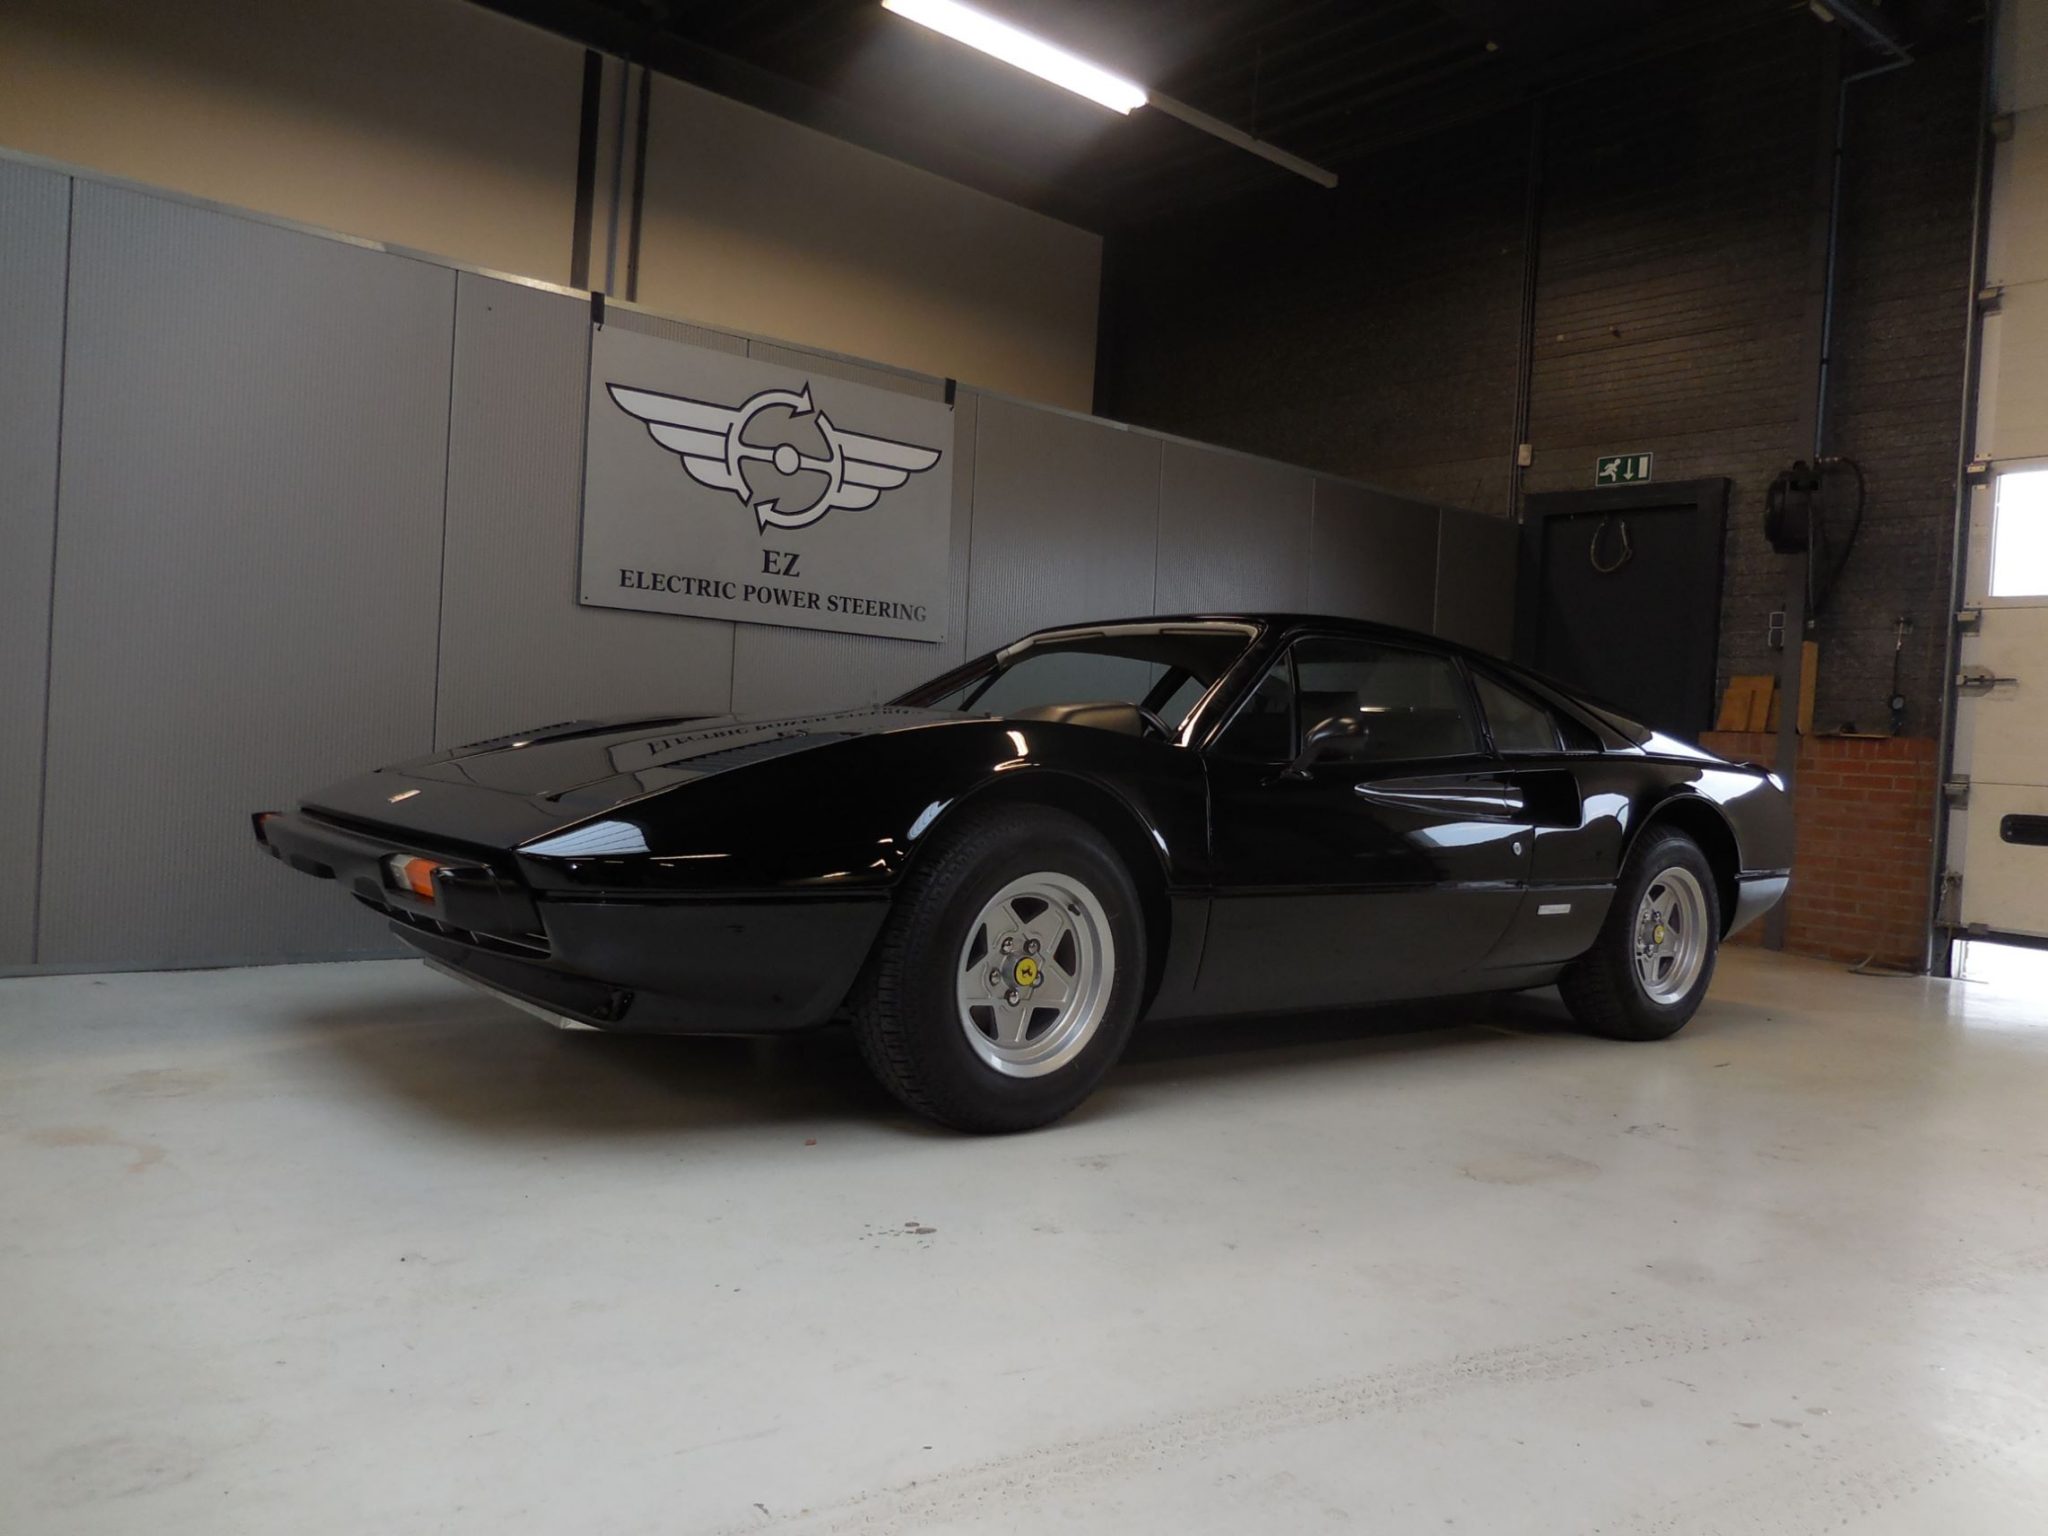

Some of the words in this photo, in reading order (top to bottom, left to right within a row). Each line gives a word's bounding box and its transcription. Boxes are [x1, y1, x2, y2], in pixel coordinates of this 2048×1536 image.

[760, 548, 801, 578] EZ
[618, 568, 737, 600] ELECTRIC
[742, 583, 822, 611] POWER
[826, 594, 927, 623] STEERING
